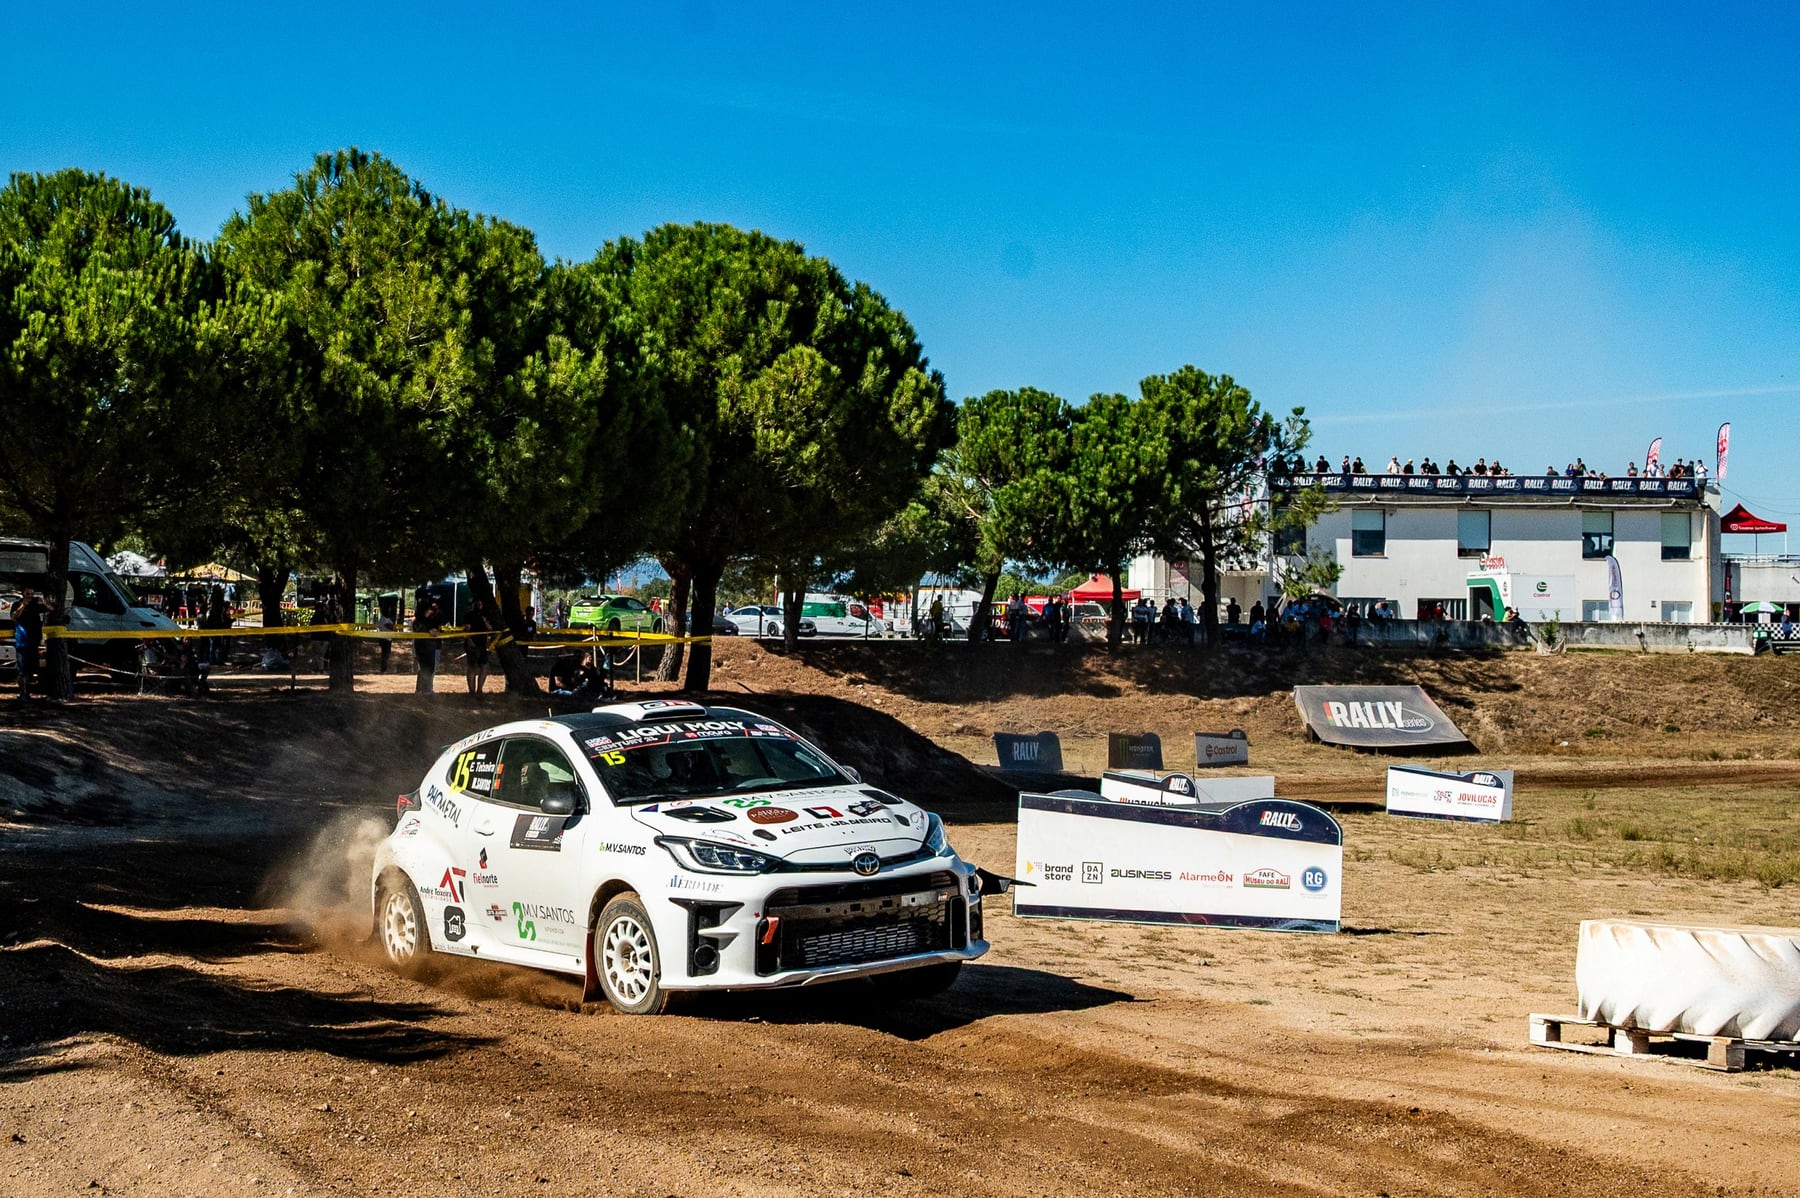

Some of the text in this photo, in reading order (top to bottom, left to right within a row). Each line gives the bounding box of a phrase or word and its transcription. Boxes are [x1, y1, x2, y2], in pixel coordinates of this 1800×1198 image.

[1353, 477, 1373, 487] RALLY
[1380, 477, 1401, 487] RALLY
[1409, 478, 1430, 488] RALLY
[1437, 478, 1457, 488] RALLY
[1468, 479, 1489, 489] RALLY
[1496, 479, 1517, 489] RALLY
[1524, 479, 1544, 489] RALLY
[1552, 479, 1572, 489] RALLY
[1584, 480, 1604, 490] RALLY
[1611, 480, 1632, 490] RALLY
[1640, 481, 1660, 491] RALLY
[1667, 481, 1688, 491] RALLY
[1329, 701, 1403, 729] RALLY
[616, 723, 684, 740] LIQUI
[684, 721, 746, 732] MOLY
[1013, 742, 1040, 761] RALLY
[1214, 744, 1238, 755] Castrol
[600, 751, 626, 766] 15
[450, 751, 476, 793] 15
[1457, 792, 1497, 804] JOVILUCAS
[1262, 810, 1296, 828] RALLY
[781, 816, 892, 834] LEITE JANEIRO
[1045, 863, 1073, 873] brand
[1045, 872, 1071, 881] store
[1111, 868, 1172, 880] BUSINESS
[1306, 871, 1323, 885] RG
[1246, 876, 1265, 885] MUSEU
